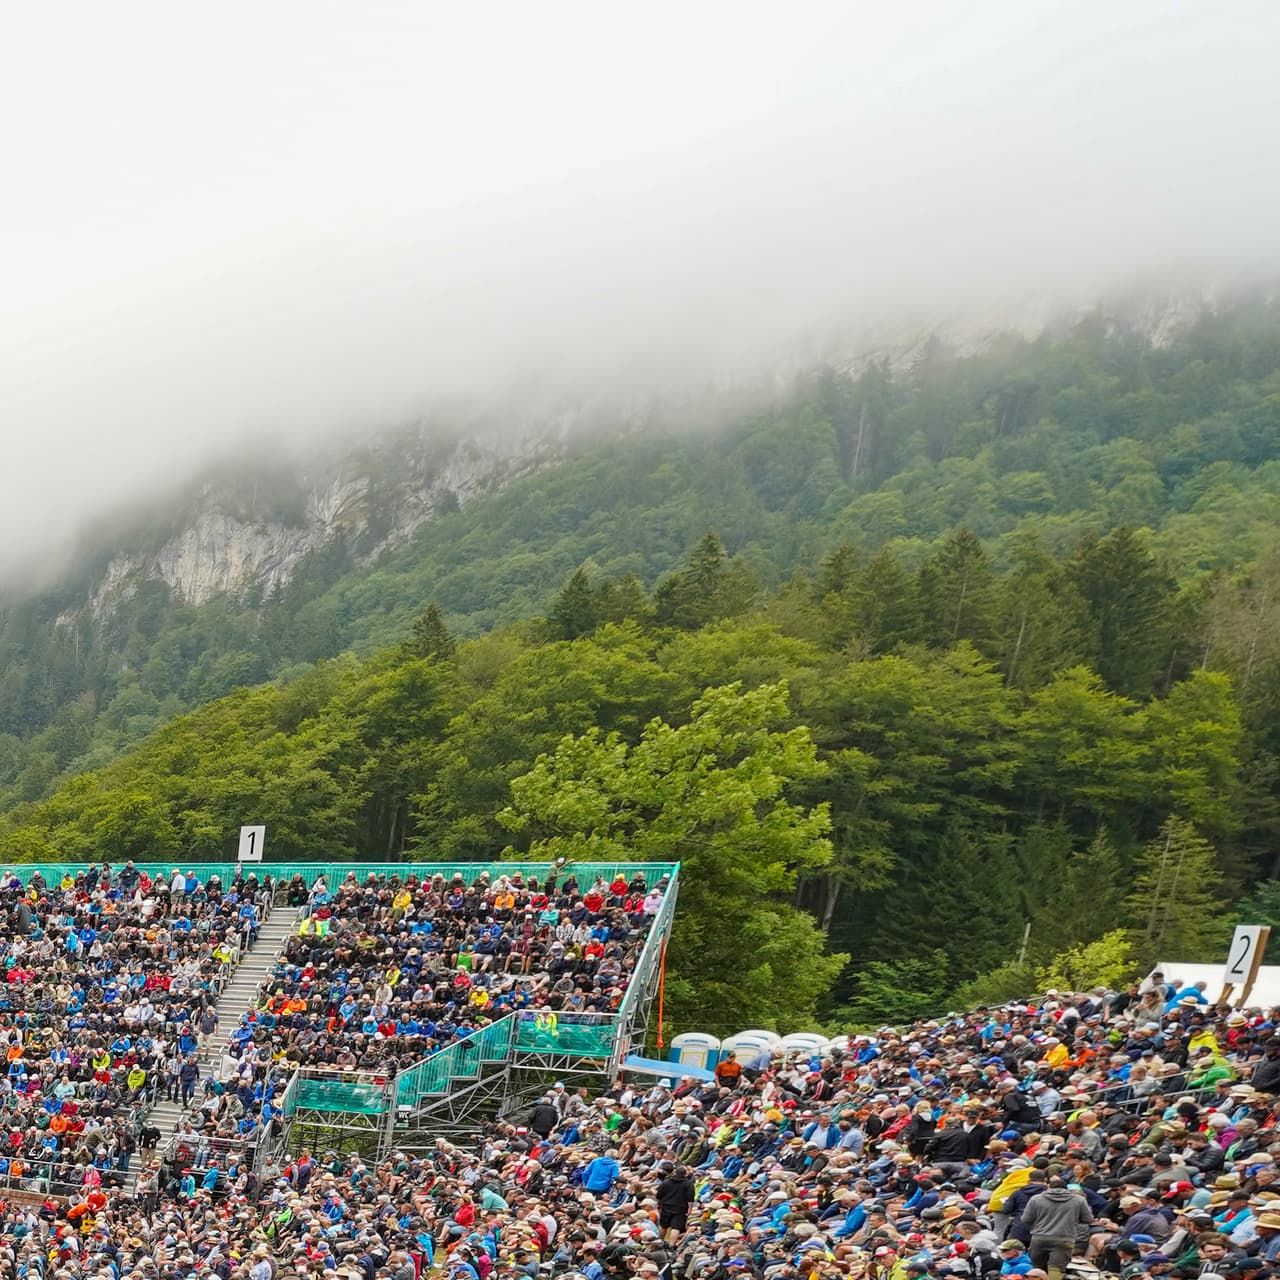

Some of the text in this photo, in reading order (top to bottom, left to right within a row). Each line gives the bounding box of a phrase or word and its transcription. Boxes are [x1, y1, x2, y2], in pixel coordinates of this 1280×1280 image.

[247, 831, 257, 855] 1
[1230, 935, 1251, 974] 2
[398, 1111, 410, 1119] WC
